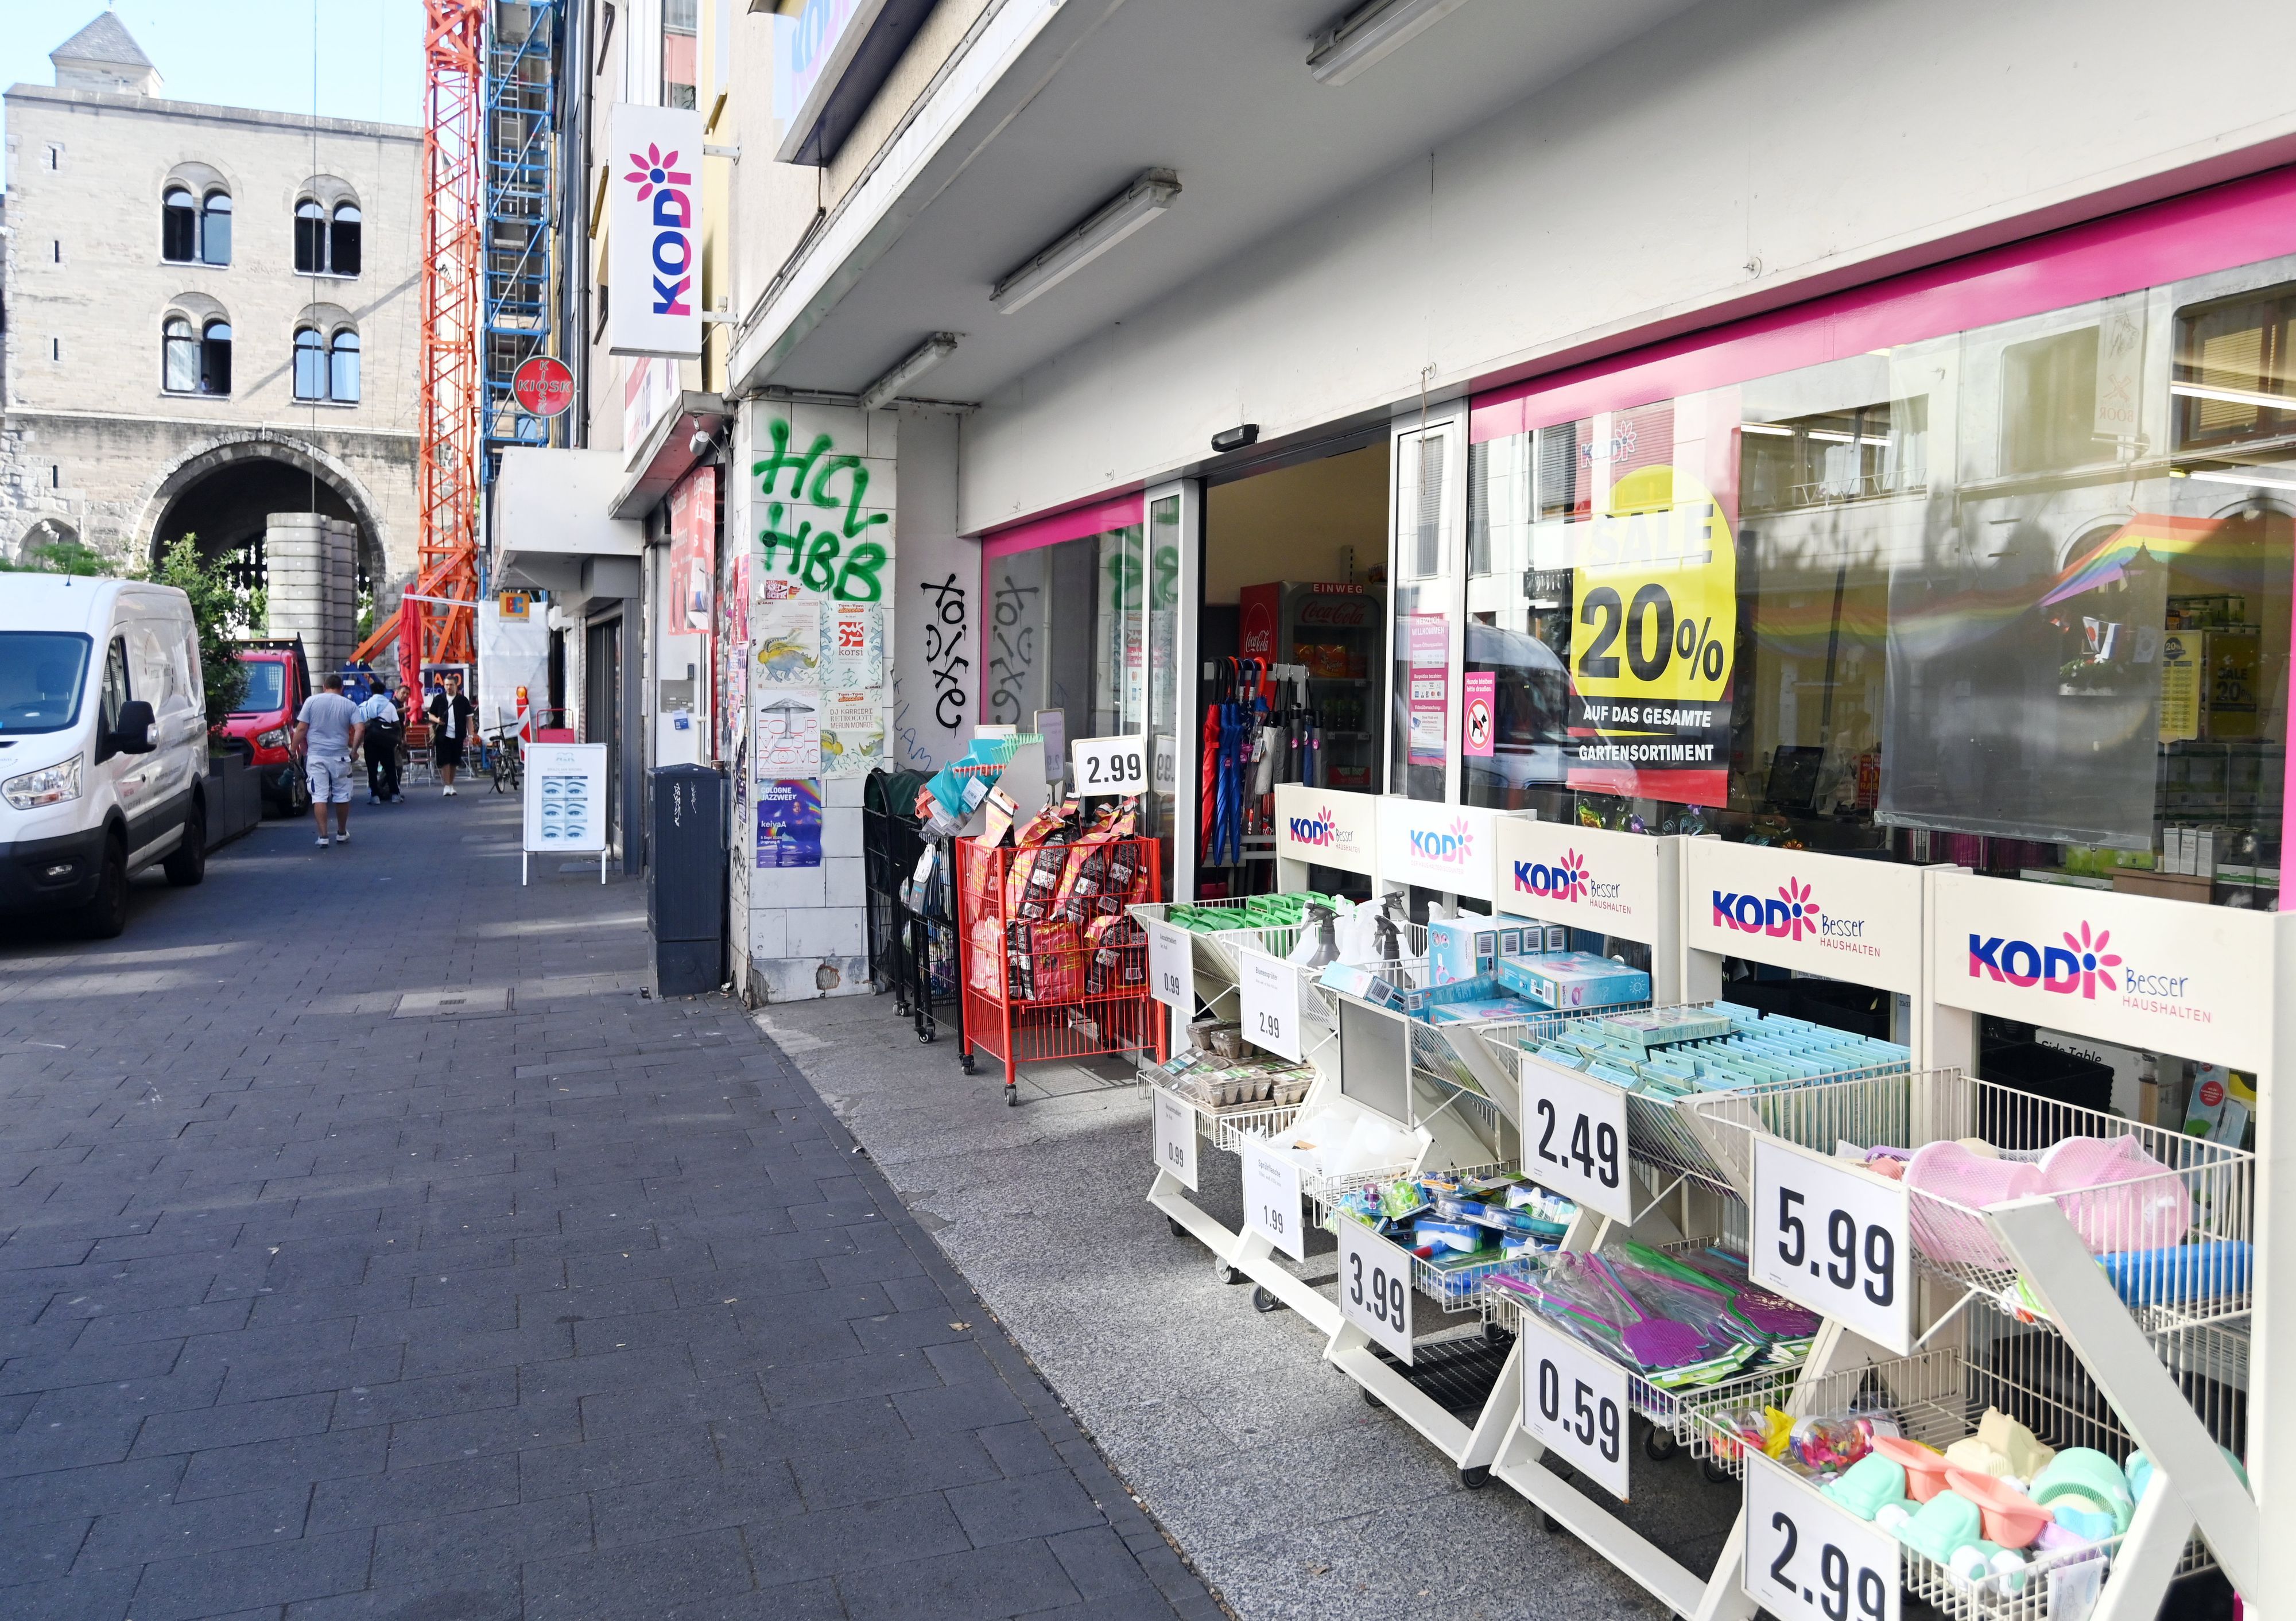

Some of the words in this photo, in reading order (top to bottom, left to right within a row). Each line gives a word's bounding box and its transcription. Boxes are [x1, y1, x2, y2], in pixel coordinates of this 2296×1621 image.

[517, 379, 572, 393] KIOSK
[537, 360, 549, 414] KIOSK
[1589, 503, 1714, 572] SALE
[758, 502, 887, 602] HBB
[1313, 584, 1363, 594] EINWEG
[506, 596, 523, 613] EC
[1411, 626, 1445, 636] WILLKOMMEN
[1416, 616, 1440, 625] HERZLICH
[1577, 583, 1724, 683] 20%
[839, 647, 863, 656] korsi
[2218, 668, 2247, 680] SALE
[759, 720, 817, 734] FOUR
[1583, 704, 1609, 721] AUF
[1612, 705, 1639, 724] DAS
[1642, 707, 1712, 727] GESAMTE
[759, 734, 818, 749] MUSH
[1578, 743, 1713, 762] GARTENSORTIMENT
[759, 749, 819, 765] ROOMS
[1087, 753, 1142, 784] 2.99
[1336, 828, 1353, 843] Besser
[1335, 843, 1361, 854] HAUSHALTEN
[1591, 879, 1620, 898] Besser
[1589, 898, 1631, 914] HAUSHALTEN
[1822, 913, 1865, 937] Besser
[1820, 937, 1880, 957] HAUSHALTEN
[1164, 972, 1180, 996] 0.99
[2126, 967, 2188, 998] Besser
[2122, 995, 2211, 1023] HAUSHALTEN
[1259, 1011, 1279, 1038] 2.99
[1169, 1142, 1184, 1168] 0.99
[1537, 1099, 1619, 1189] 2.49
[1263, 1205, 1283, 1234] 1.99
[1778, 1186, 1895, 1307] 5.99
[1349, 1252, 1405, 1333] 3.99
[1539, 1358, 1620, 1463] 0.59
[1770, 1511, 1886, 1621] 2.99
